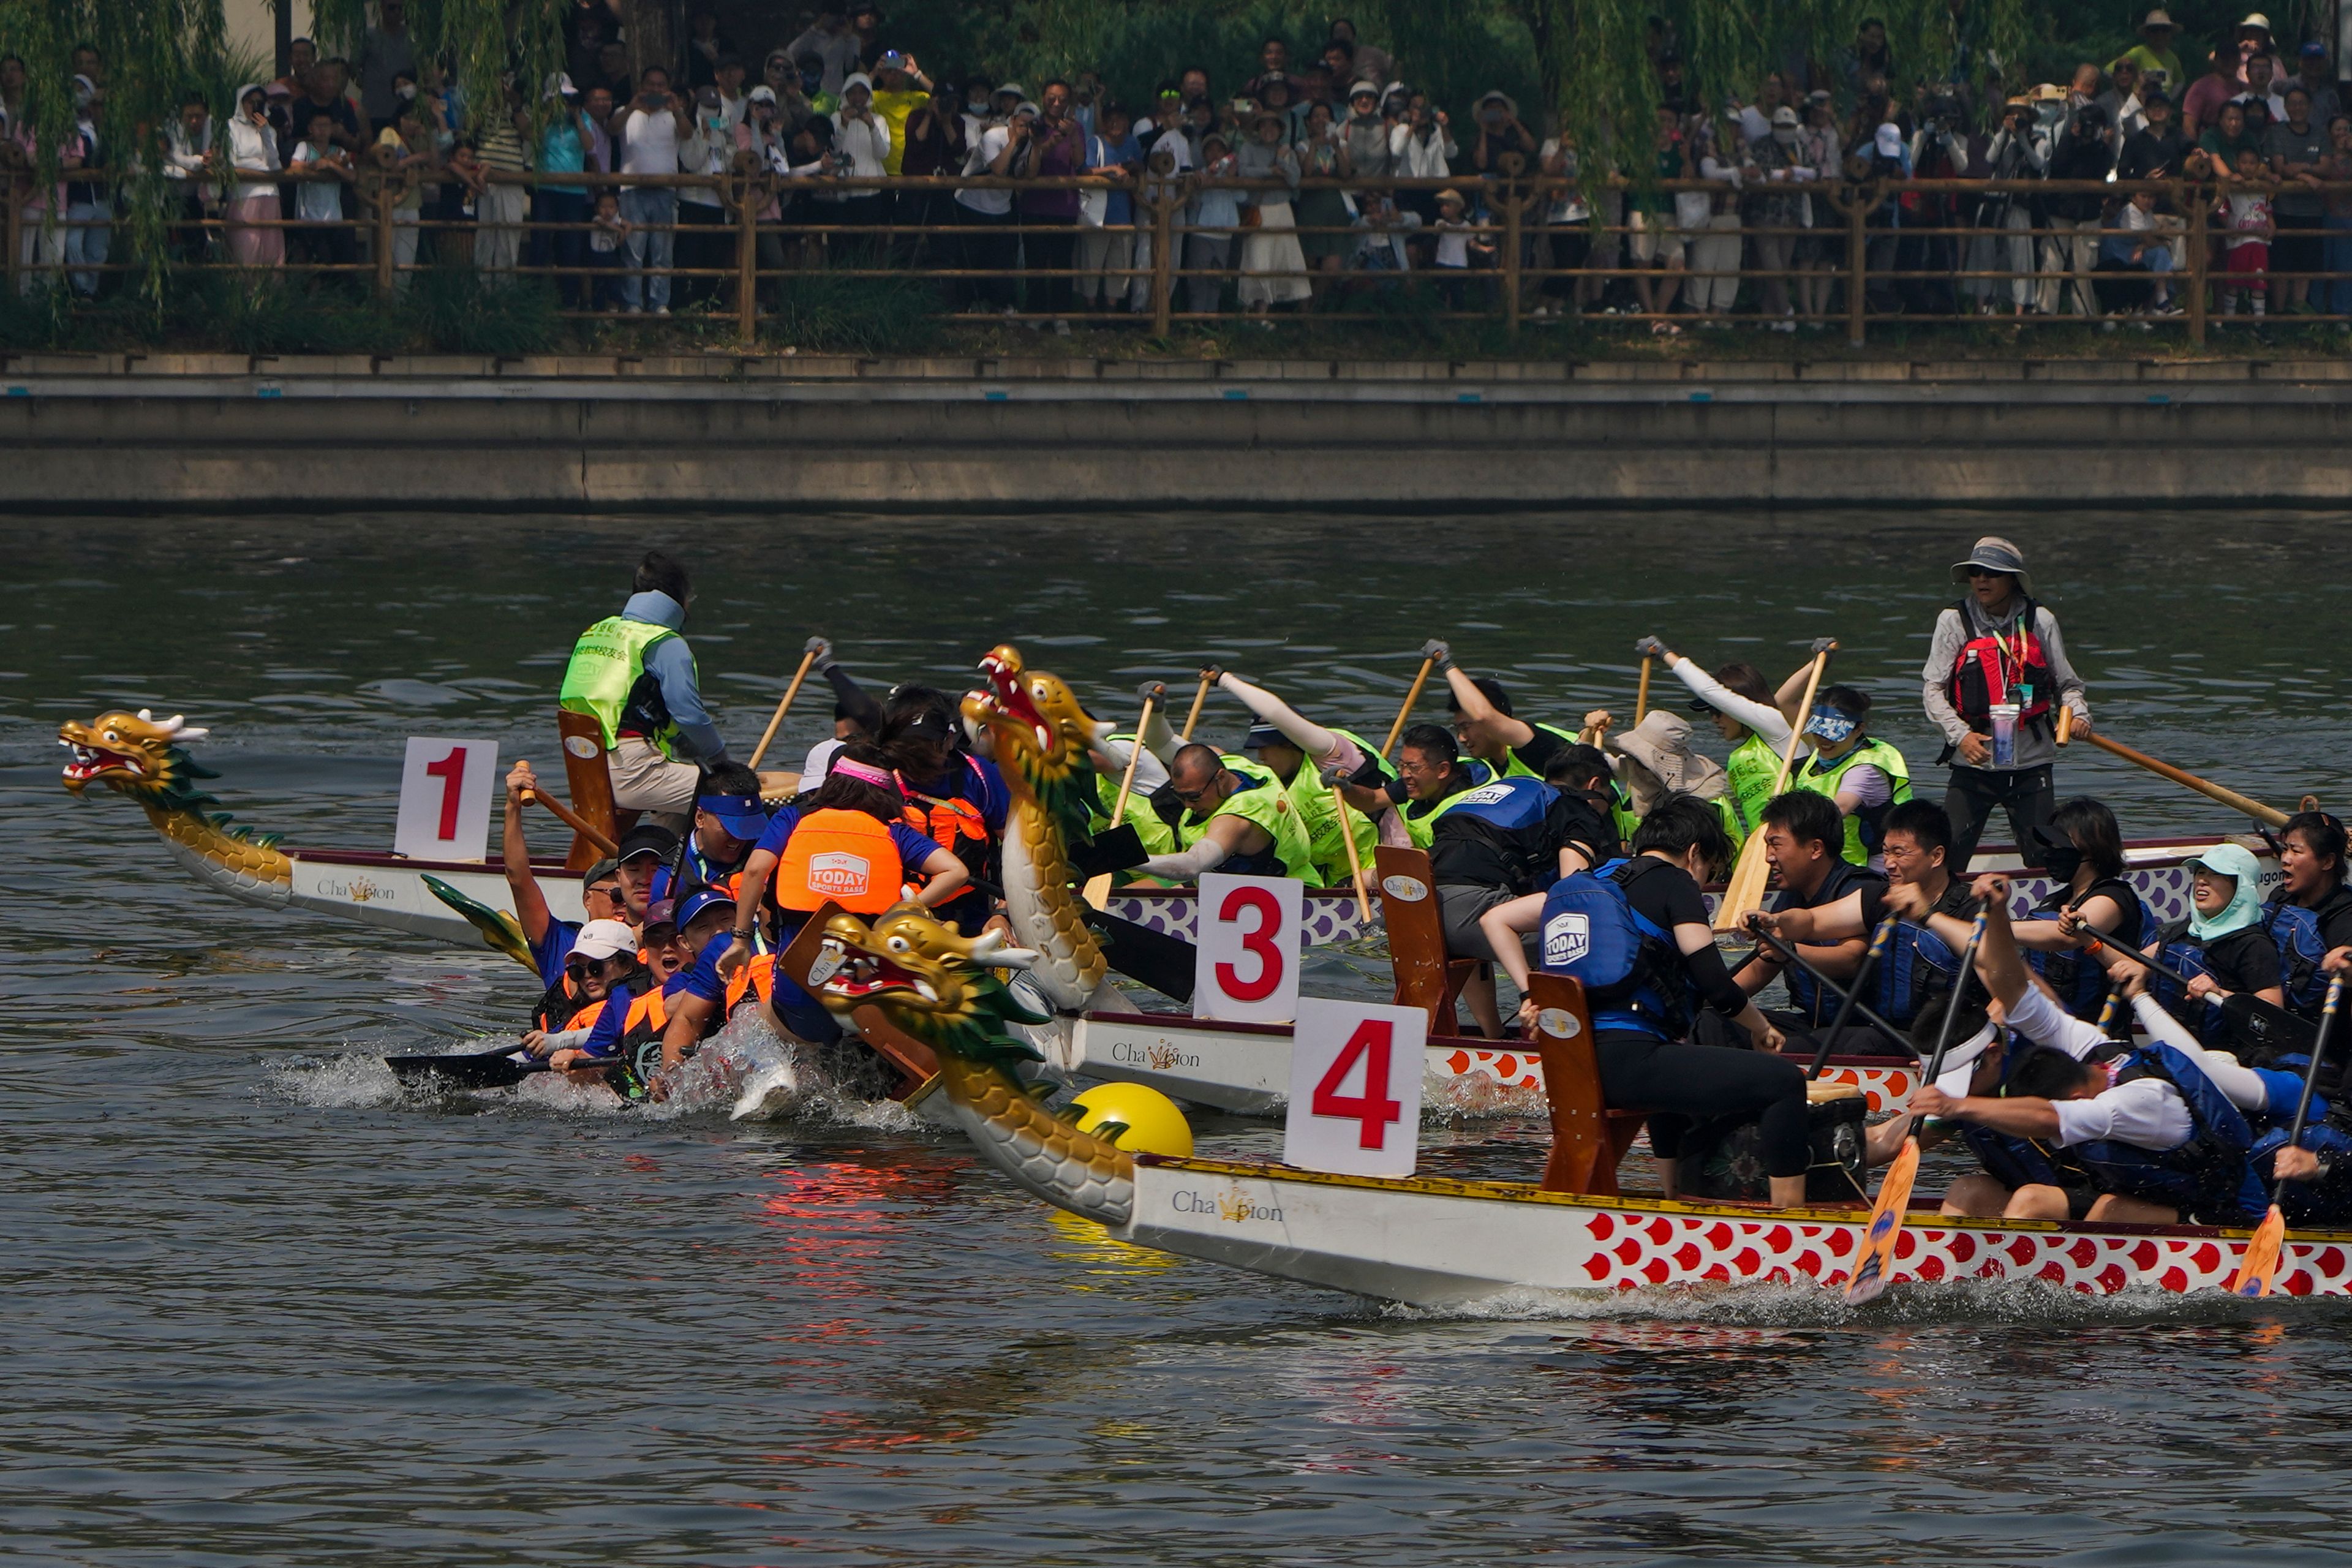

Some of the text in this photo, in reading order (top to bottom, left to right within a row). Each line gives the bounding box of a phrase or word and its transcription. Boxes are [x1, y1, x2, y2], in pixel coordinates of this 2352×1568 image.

[427, 747, 467, 841] 1
[812, 881, 842, 892] SPORTS
[813, 870, 865, 886] TODAY
[2260, 872, 2284, 886] gon
[1215, 886, 1283, 1001] 3
[1547, 934, 1586, 954] TODAY
[1311, 1019, 1401, 1150] 4
